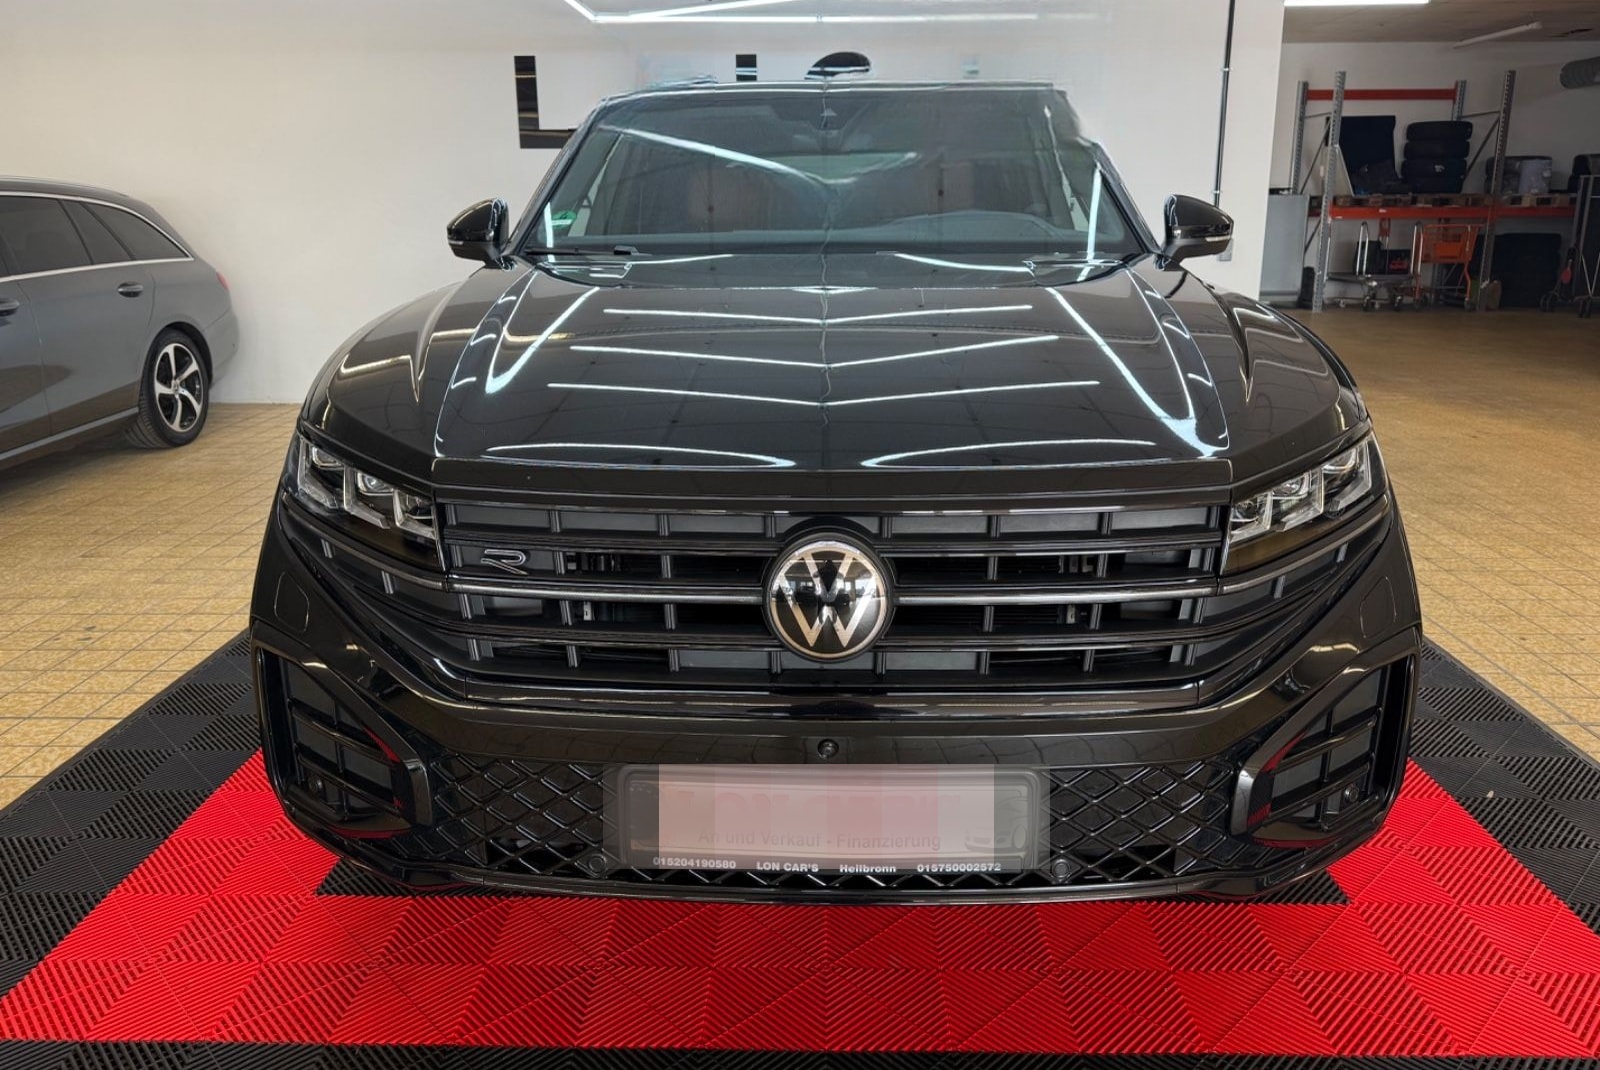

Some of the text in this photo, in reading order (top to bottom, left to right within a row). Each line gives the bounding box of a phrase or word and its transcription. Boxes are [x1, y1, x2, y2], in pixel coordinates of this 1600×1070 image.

[726, 831, 755, 845] und
[760, 831, 820, 848] Verkauf
[836, 832, 941, 851] Finanzierung
[652, 856, 1001, 873] 015204190580 LON CAR'S Heilbronn 015750002572
